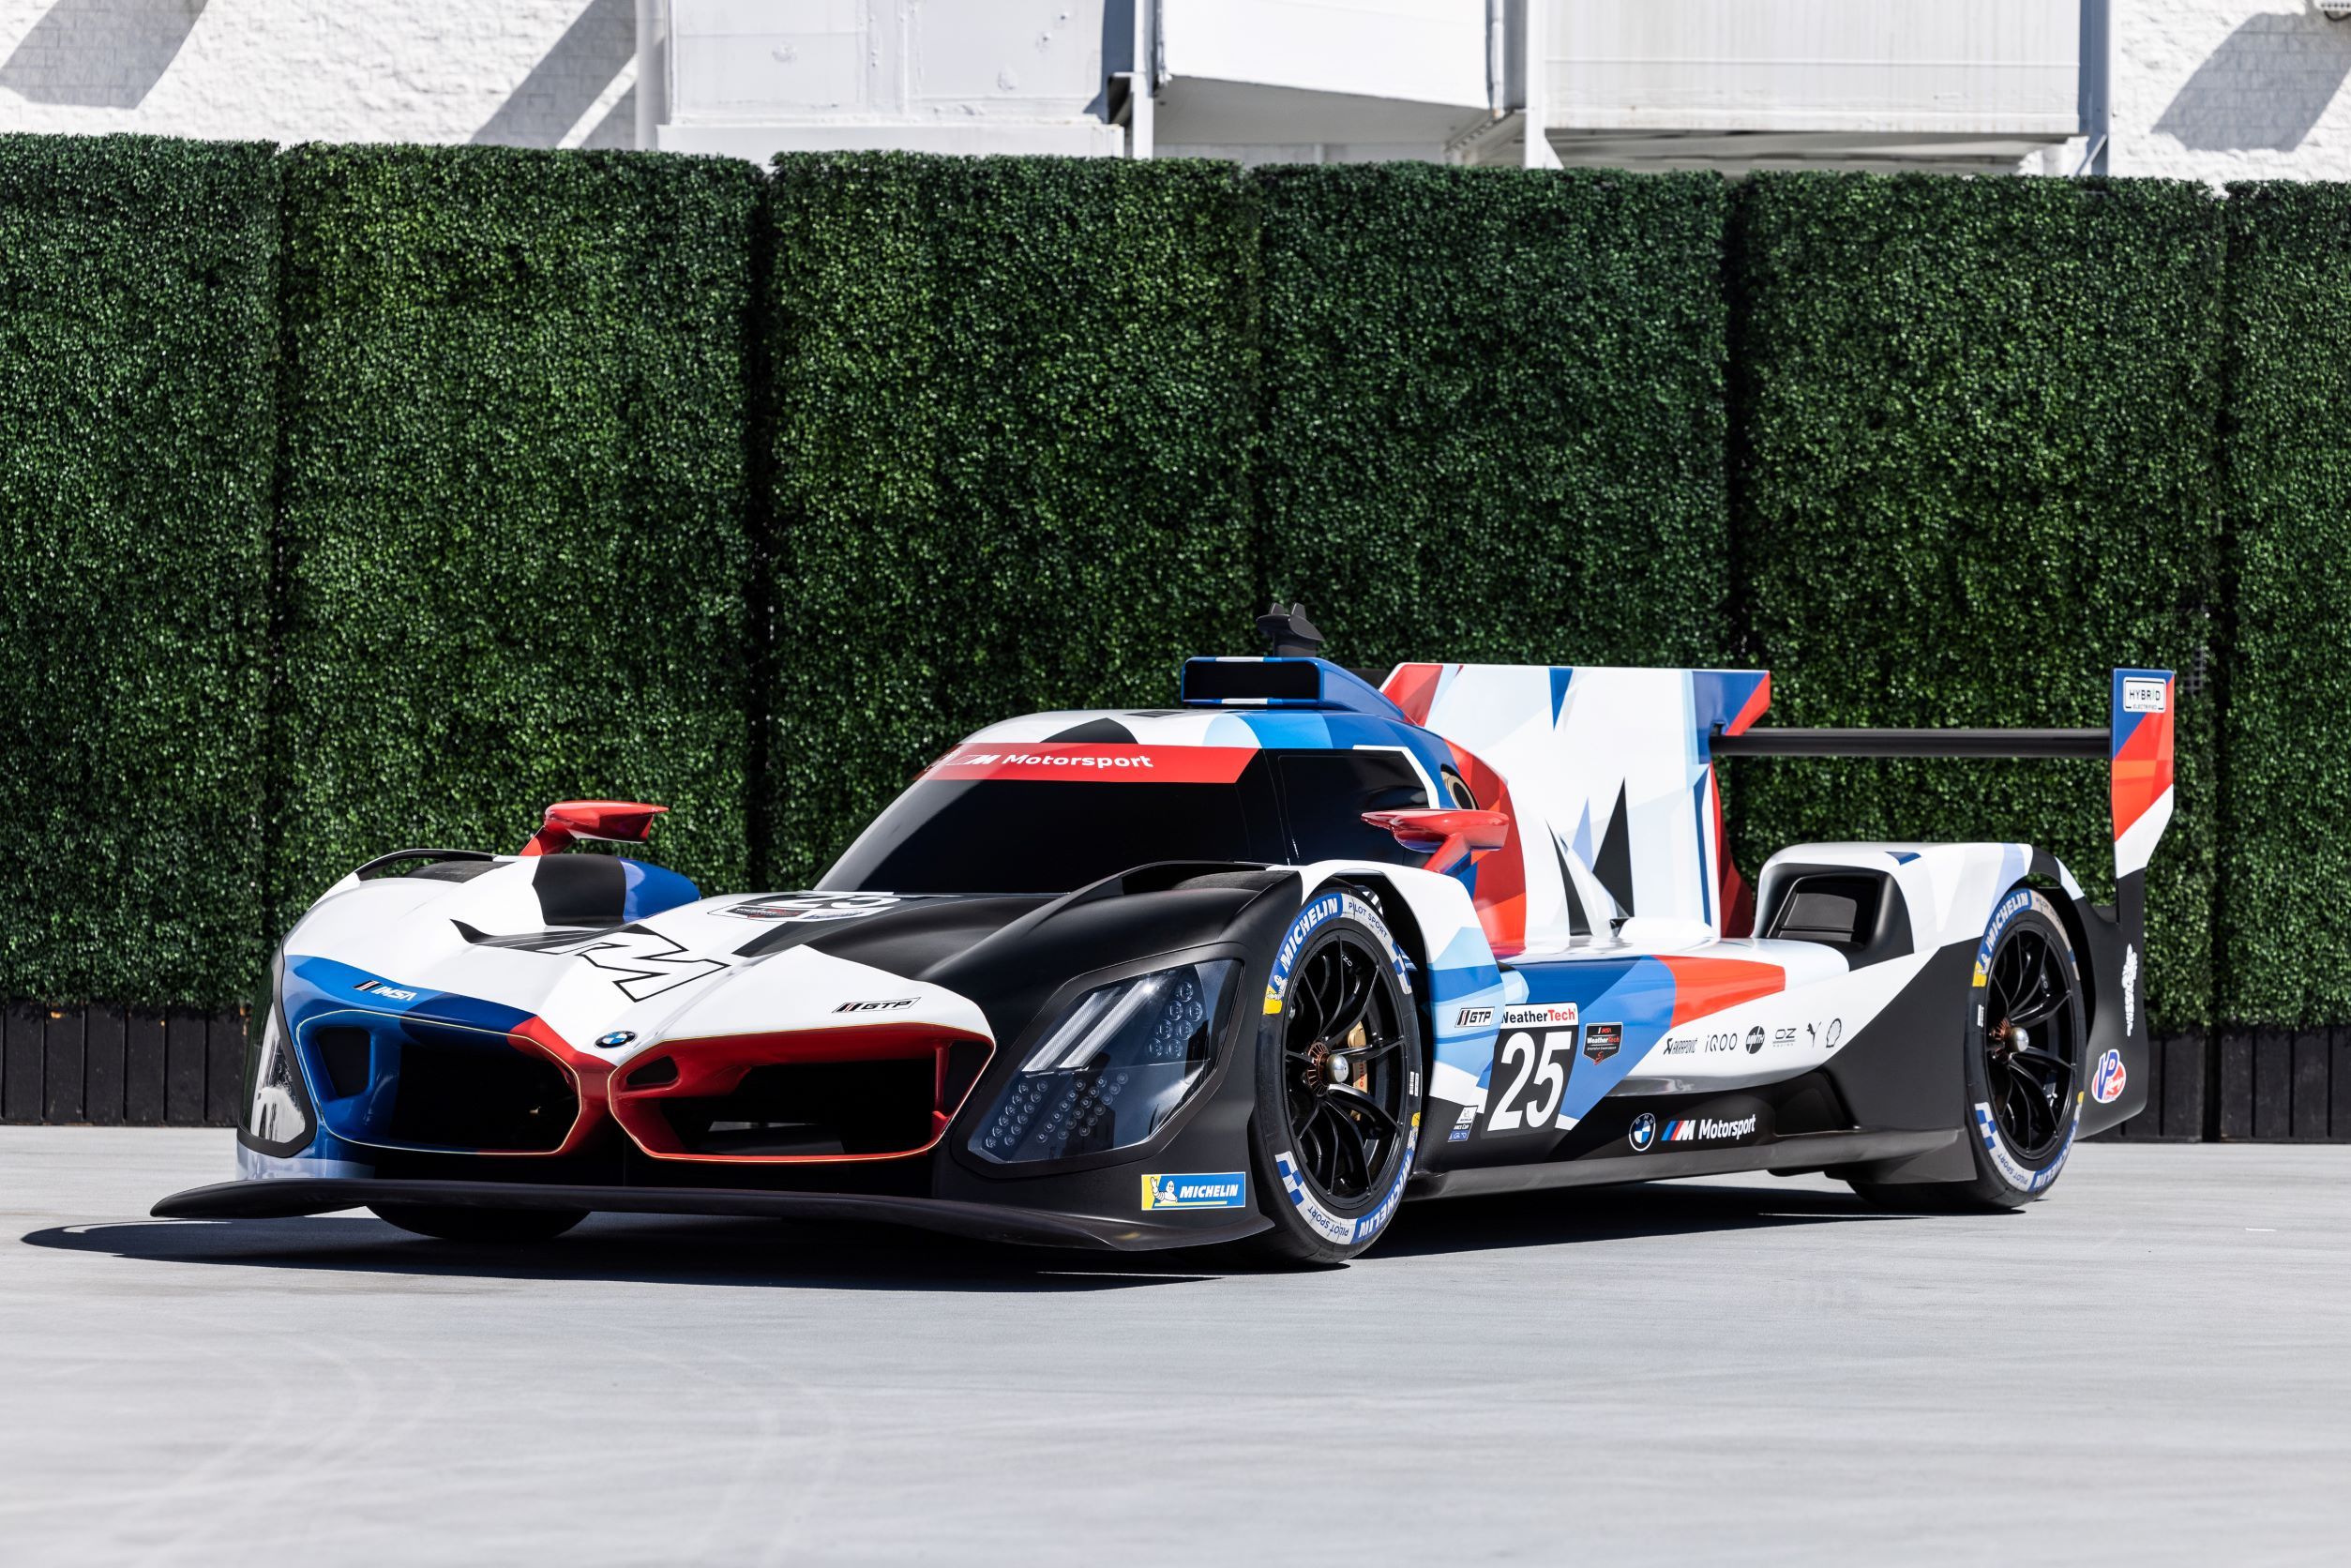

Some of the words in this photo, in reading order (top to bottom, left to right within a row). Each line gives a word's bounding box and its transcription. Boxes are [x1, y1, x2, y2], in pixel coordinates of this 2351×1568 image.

[1002, 753, 1153, 769] Motorsport
[1349, 901, 1367, 915] PILOT
[1367, 912, 1388, 938] SPORT
[1985, 892, 2029, 953] MICHELIN
[1279, 897, 1338, 973] MICHELIN
[860, 1000, 912, 1010] GTP
[1469, 1010, 1492, 1024] GTP
[1775, 1028, 1797, 1040] OZ
[1487, 1031, 1573, 1132] 25
[2096, 1049, 2120, 1100] VP
[1698, 1113, 1756, 1140] Motorsport
[1997, 1153, 2014, 1177] SPORT
[1179, 1184, 1239, 1199] MICHELIN
[1307, 1206, 1331, 1229] SPORT
[1330, 1223, 1349, 1237] PILOT
